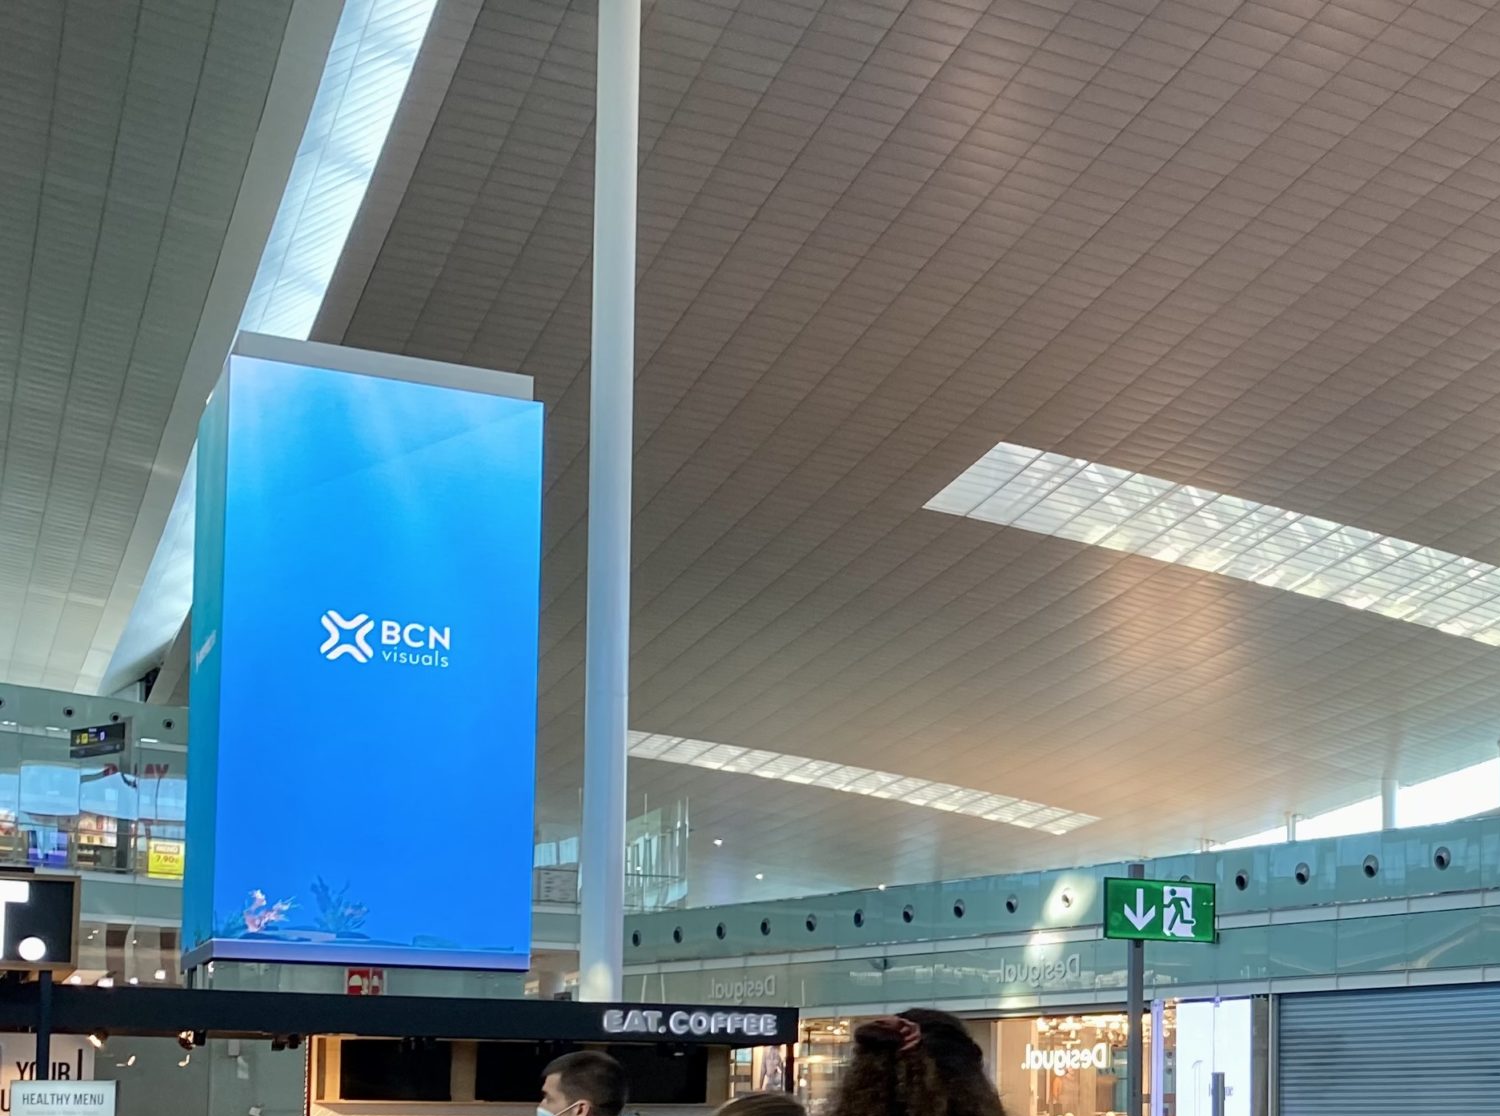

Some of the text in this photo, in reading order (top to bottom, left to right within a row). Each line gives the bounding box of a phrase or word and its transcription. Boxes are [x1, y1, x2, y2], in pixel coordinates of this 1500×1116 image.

[381, 620, 450, 650] BCN
[381, 646, 449, 668] visuals
[22, 1093, 104, 1105] HEALTHY MENU
